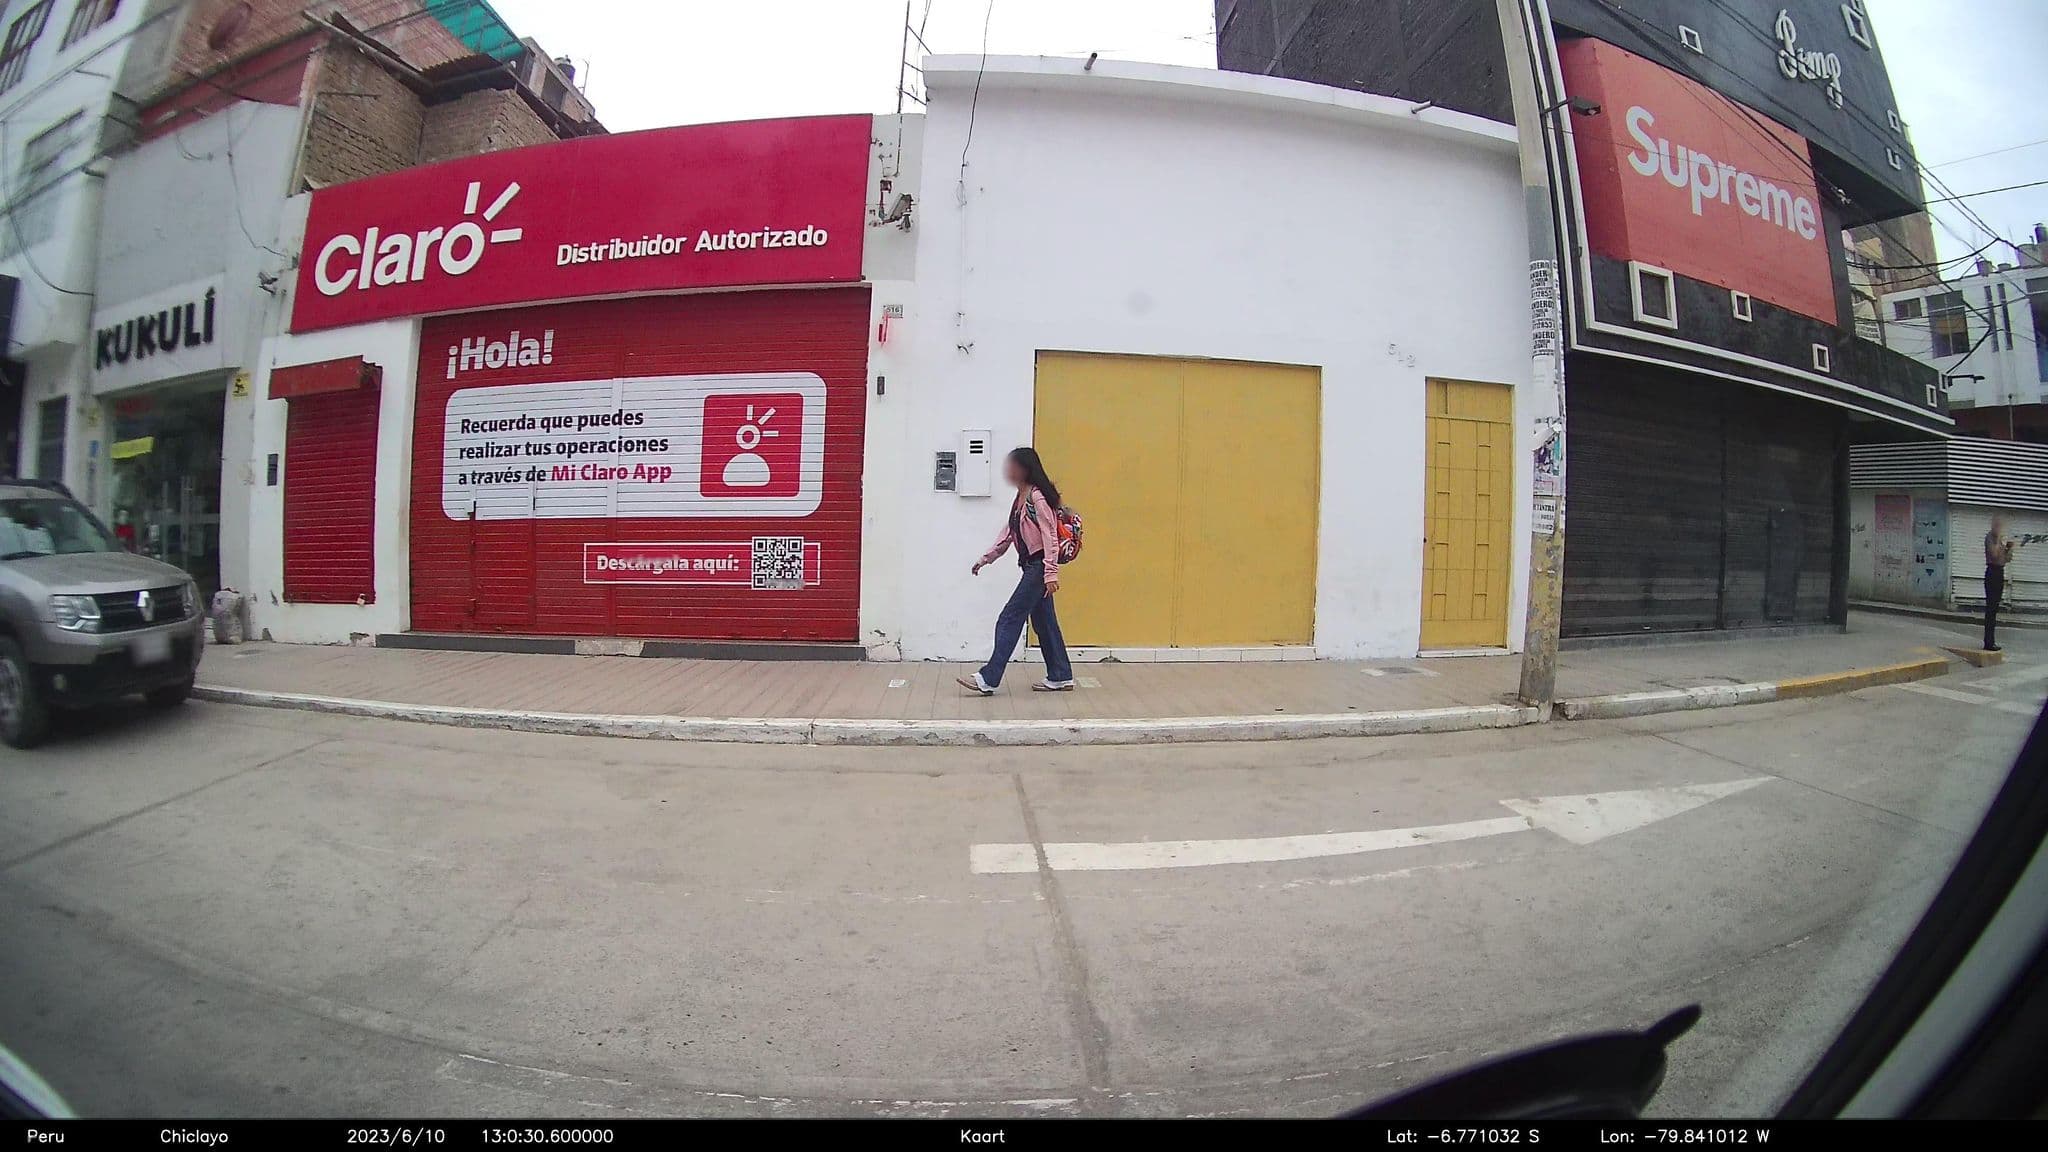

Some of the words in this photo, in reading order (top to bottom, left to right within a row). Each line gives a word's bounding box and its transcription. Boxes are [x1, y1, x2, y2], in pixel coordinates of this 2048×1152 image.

[1626, 105, 1816, 240] Supreme
[316, 223, 484, 296] Claro
[556, 234, 687, 266] Distribuidor
[694, 224, 828, 252] Autorizado
[96, 286, 215, 370] KUKULÍ
[446, 329, 554, 379] ¡Hola!
[461, 414, 536, 434] Recuerda
[540, 416, 573, 433] que
[577, 409, 644, 431] puedes
[459, 442, 521, 459] realizar
[525, 442, 551, 456] tus
[555, 436, 669, 458] operaciones
[458, 473, 467, 485] a
[471, 467, 521, 484] través
[525, 466, 546, 481] de
[551, 465, 576, 481] Mi
[580, 464, 628, 481] Claro
[632, 463, 672, 483] App
[693, 554, 739, 574] aquí:
